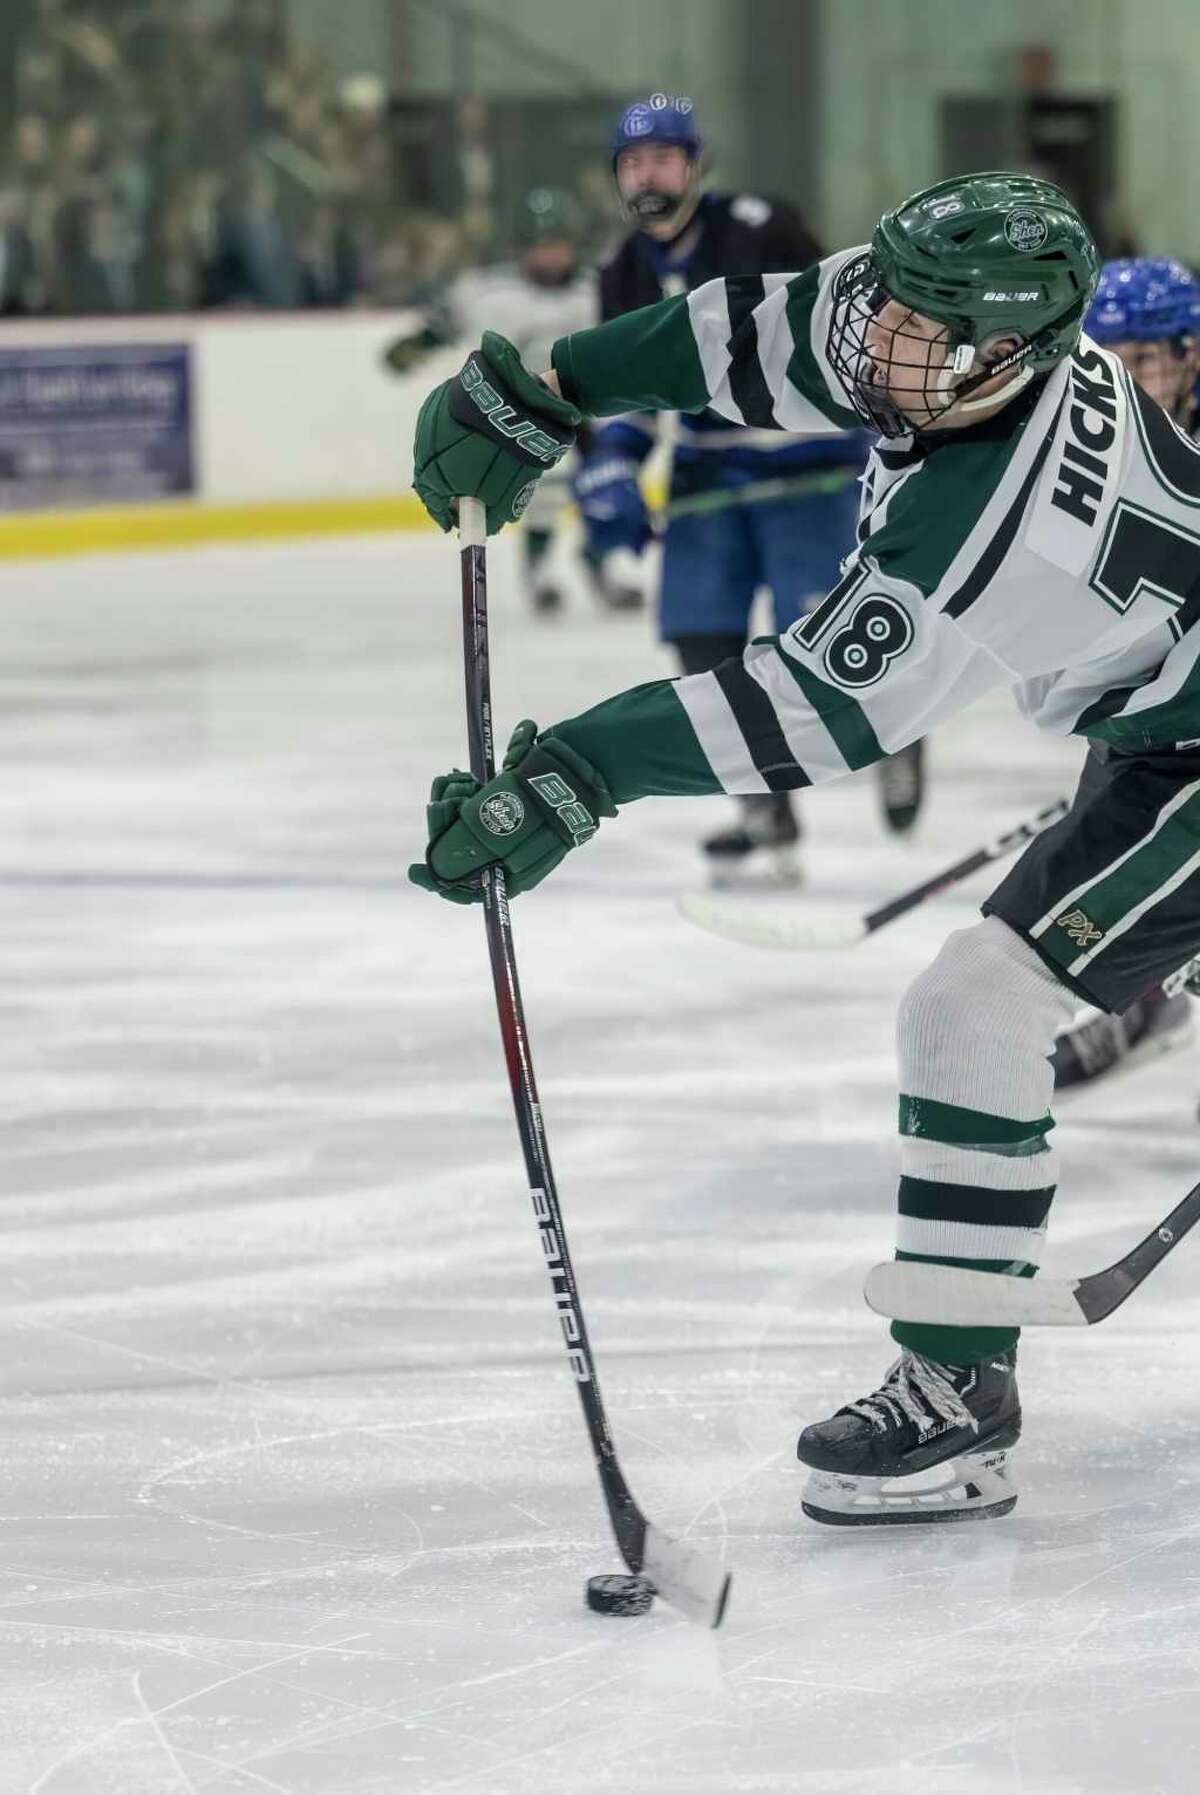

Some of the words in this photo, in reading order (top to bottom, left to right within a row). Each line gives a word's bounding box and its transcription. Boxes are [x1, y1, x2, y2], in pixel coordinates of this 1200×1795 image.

[983, 291, 1039, 301] BAUER
[991, 344, 1033, 375] BAUER
[1050, 348, 1119, 528] HICKS
[792, 552, 915, 690] 18
[1056, 909, 1103, 947] PX
